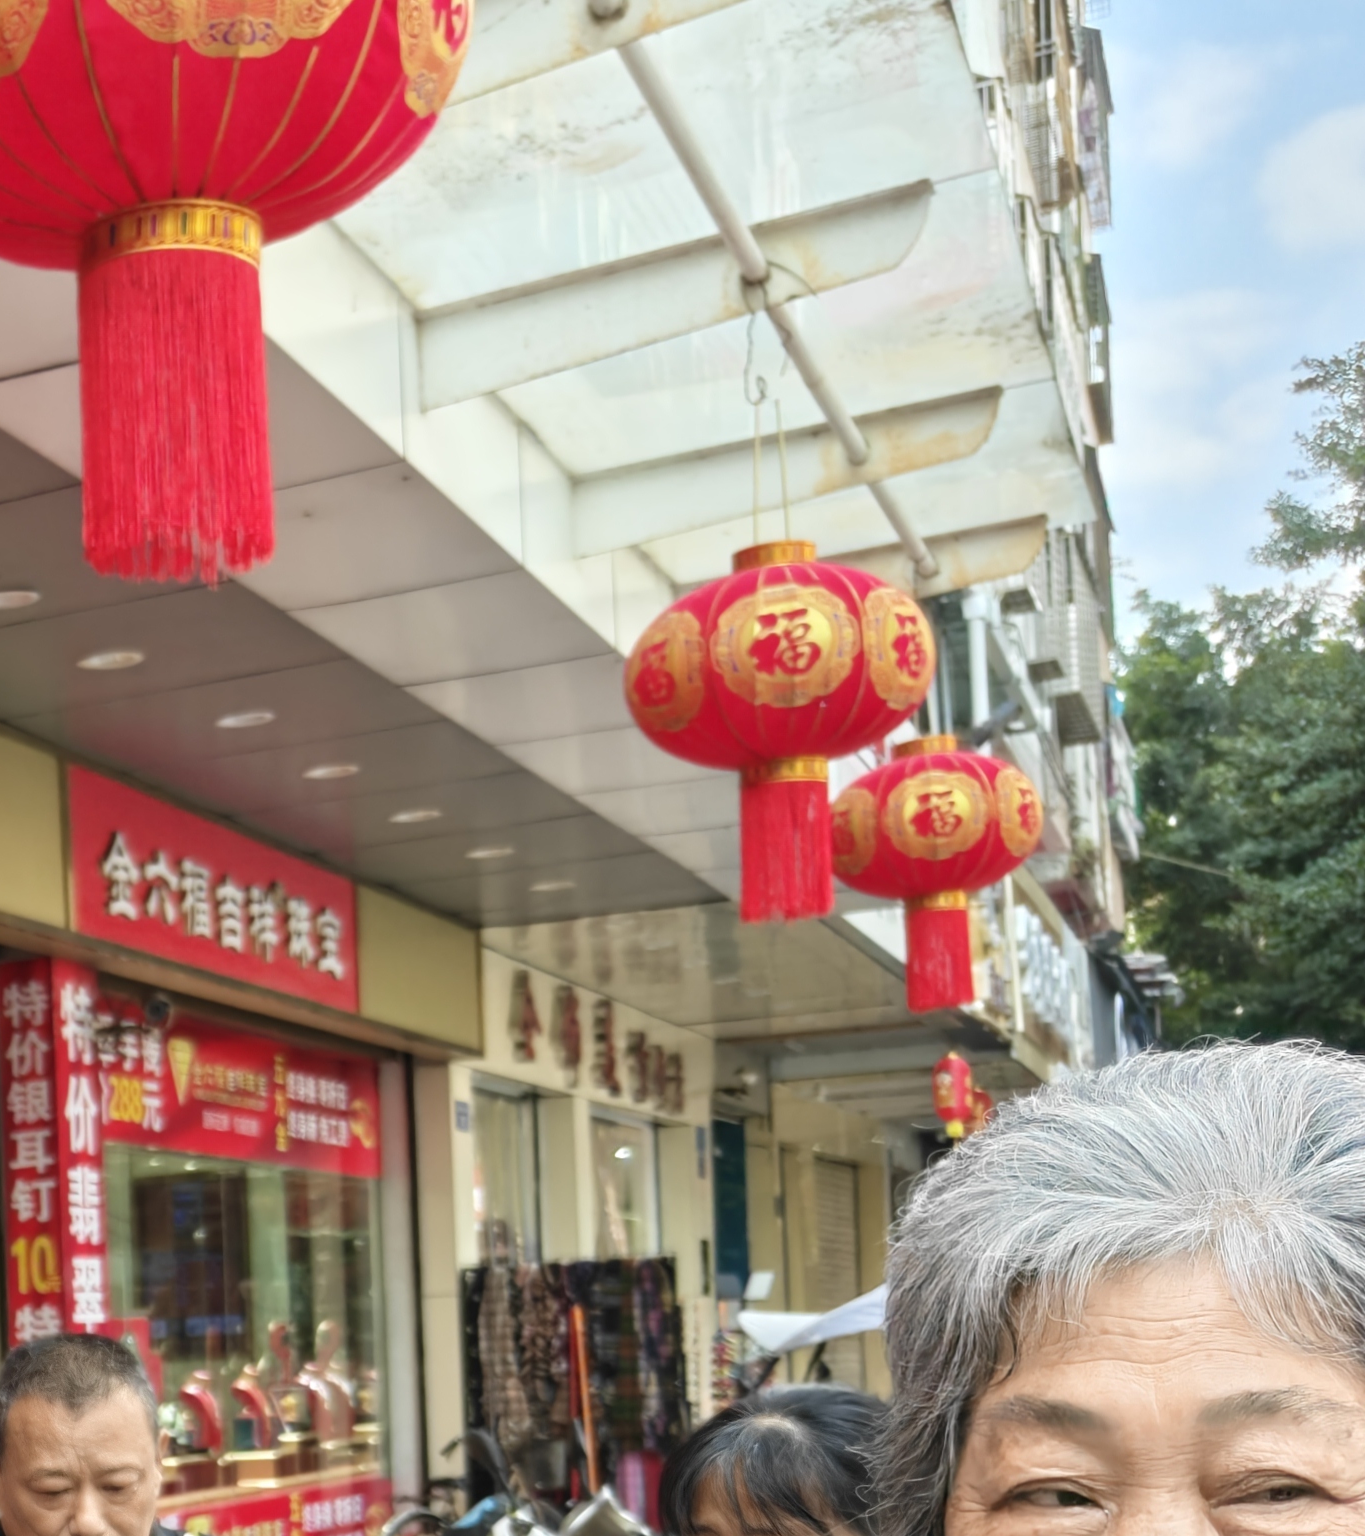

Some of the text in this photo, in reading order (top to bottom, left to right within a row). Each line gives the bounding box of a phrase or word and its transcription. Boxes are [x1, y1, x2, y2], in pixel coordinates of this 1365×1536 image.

[747, 607, 823, 676] 福
[909, 790, 963, 838] 福
[102, 830, 347, 981] 金六福吉祥珠宝
